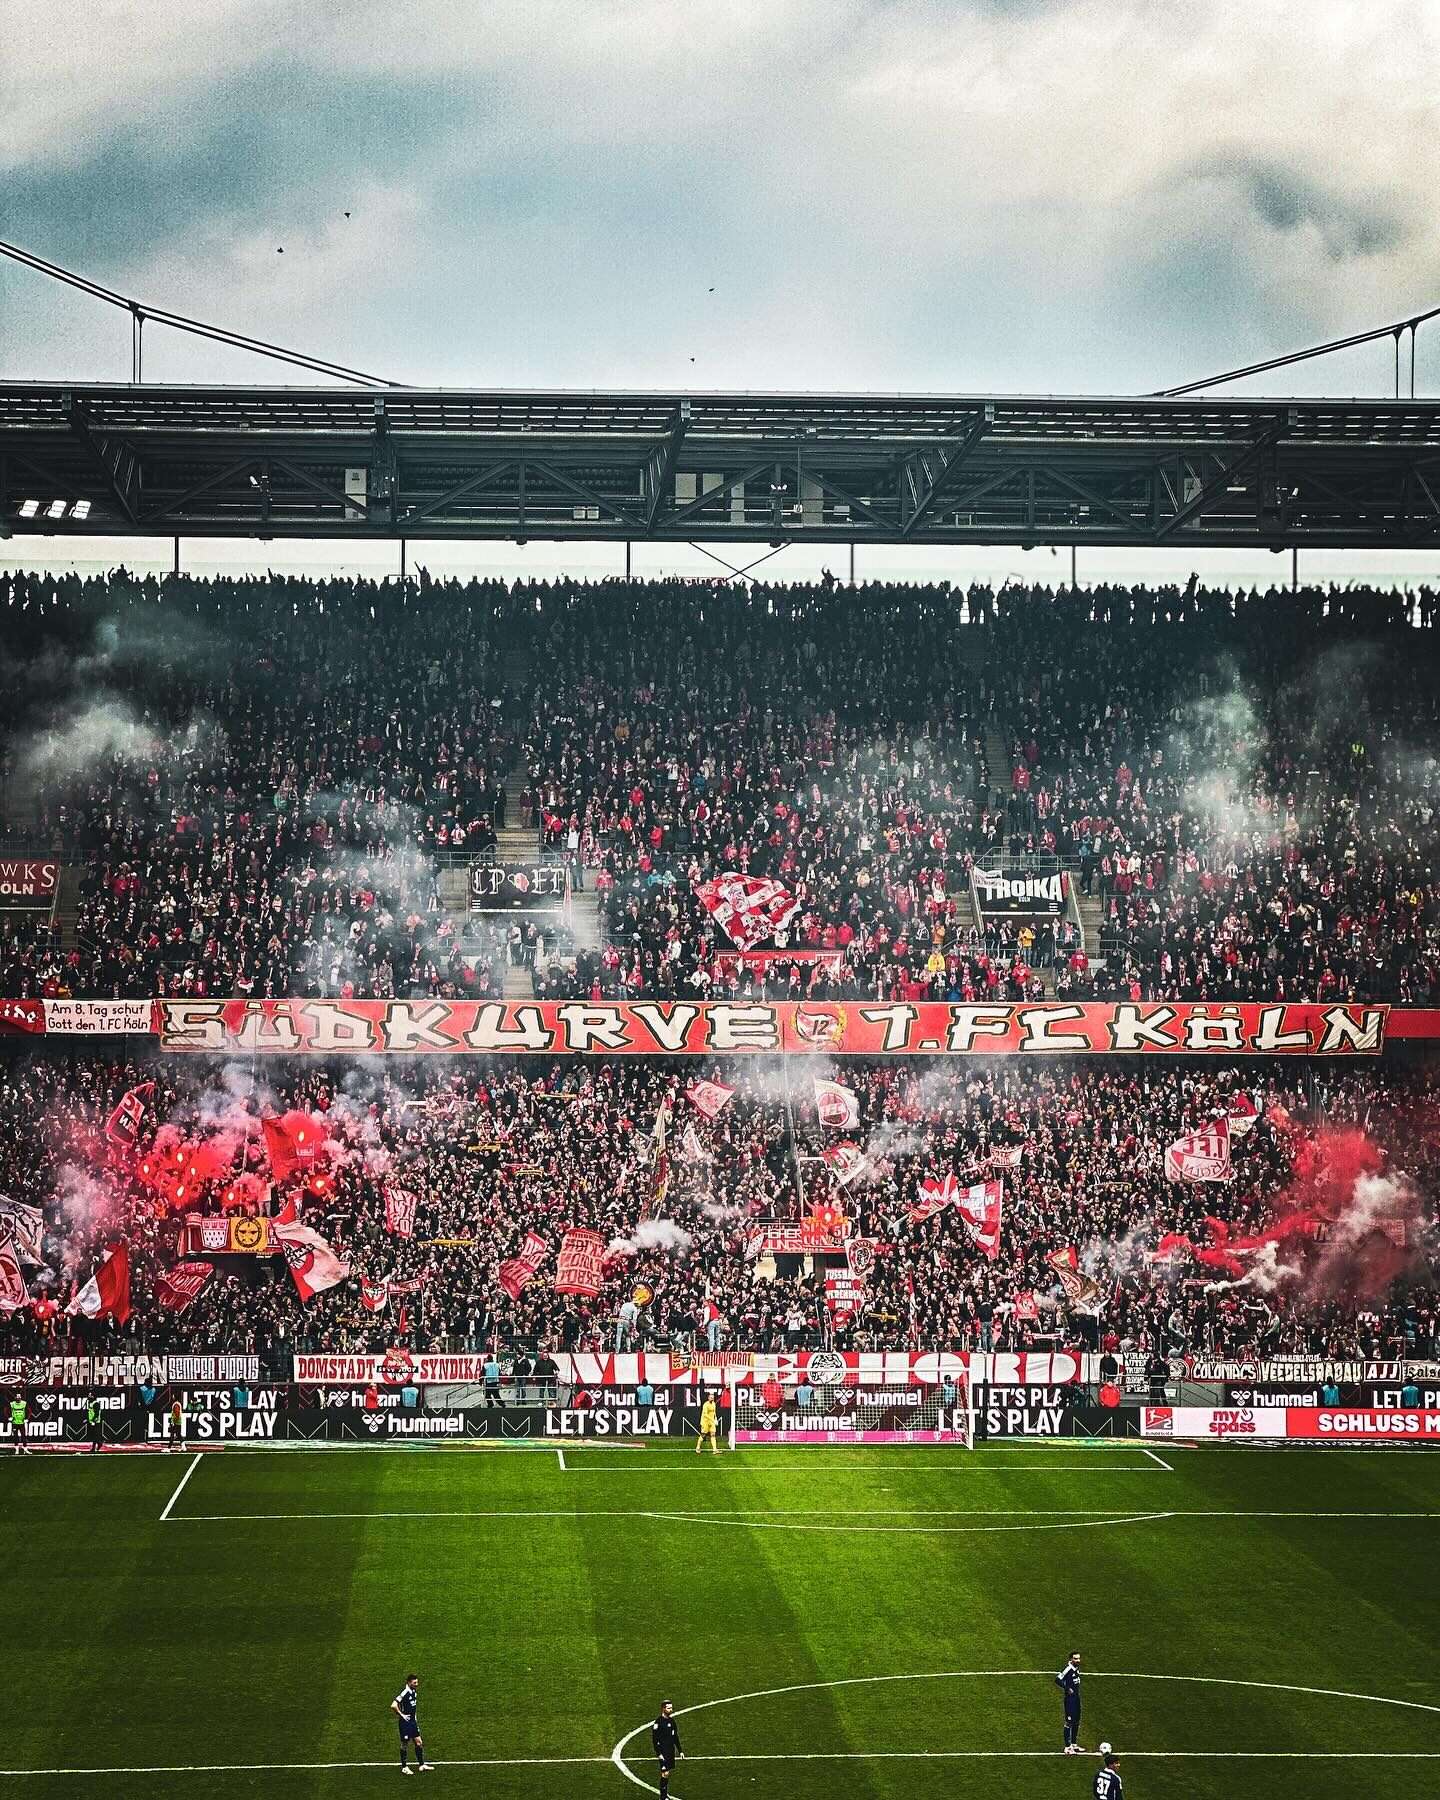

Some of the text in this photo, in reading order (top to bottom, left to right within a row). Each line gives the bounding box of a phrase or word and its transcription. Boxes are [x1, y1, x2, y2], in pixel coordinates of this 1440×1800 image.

[53, 1003, 146, 1017] Am 8. Tag schuf
[50, 1017, 73, 1029] Gott
[77, 1019, 96, 1030] den
[109, 1018, 122, 1030] FC
[48, 1356, 167, 1386] FRAKTION
[299, 1358, 484, 1381] DOMSTADT SYNDIKA
[1193, 1362, 1256, 1380] COLONIACS
[247, 1391, 278, 1410] LAY
[604, 1389, 670, 1406] humel
[857, 1389, 922, 1406] hummel
[1031, 1388, 1062, 1407] PLA
[1253, 1390, 1318, 1407] hummel
[220, 1412, 278, 1437] PLAY
[388, 1412, 464, 1433] hummel
[547, 1409, 673, 1435] LET'S PLAY
[782, 1411, 857, 1432] hummel
[1007, 1408, 1064, 1434] PLAY
[1213, 1410, 1240, 1424] my
[1318, 1413, 1420, 1433] SCHLUSS
[0, 1417, 63, 1437] umel
[1208, 1421, 1256, 1437] spass
[1097, 1777, 1111, 1797] 37
